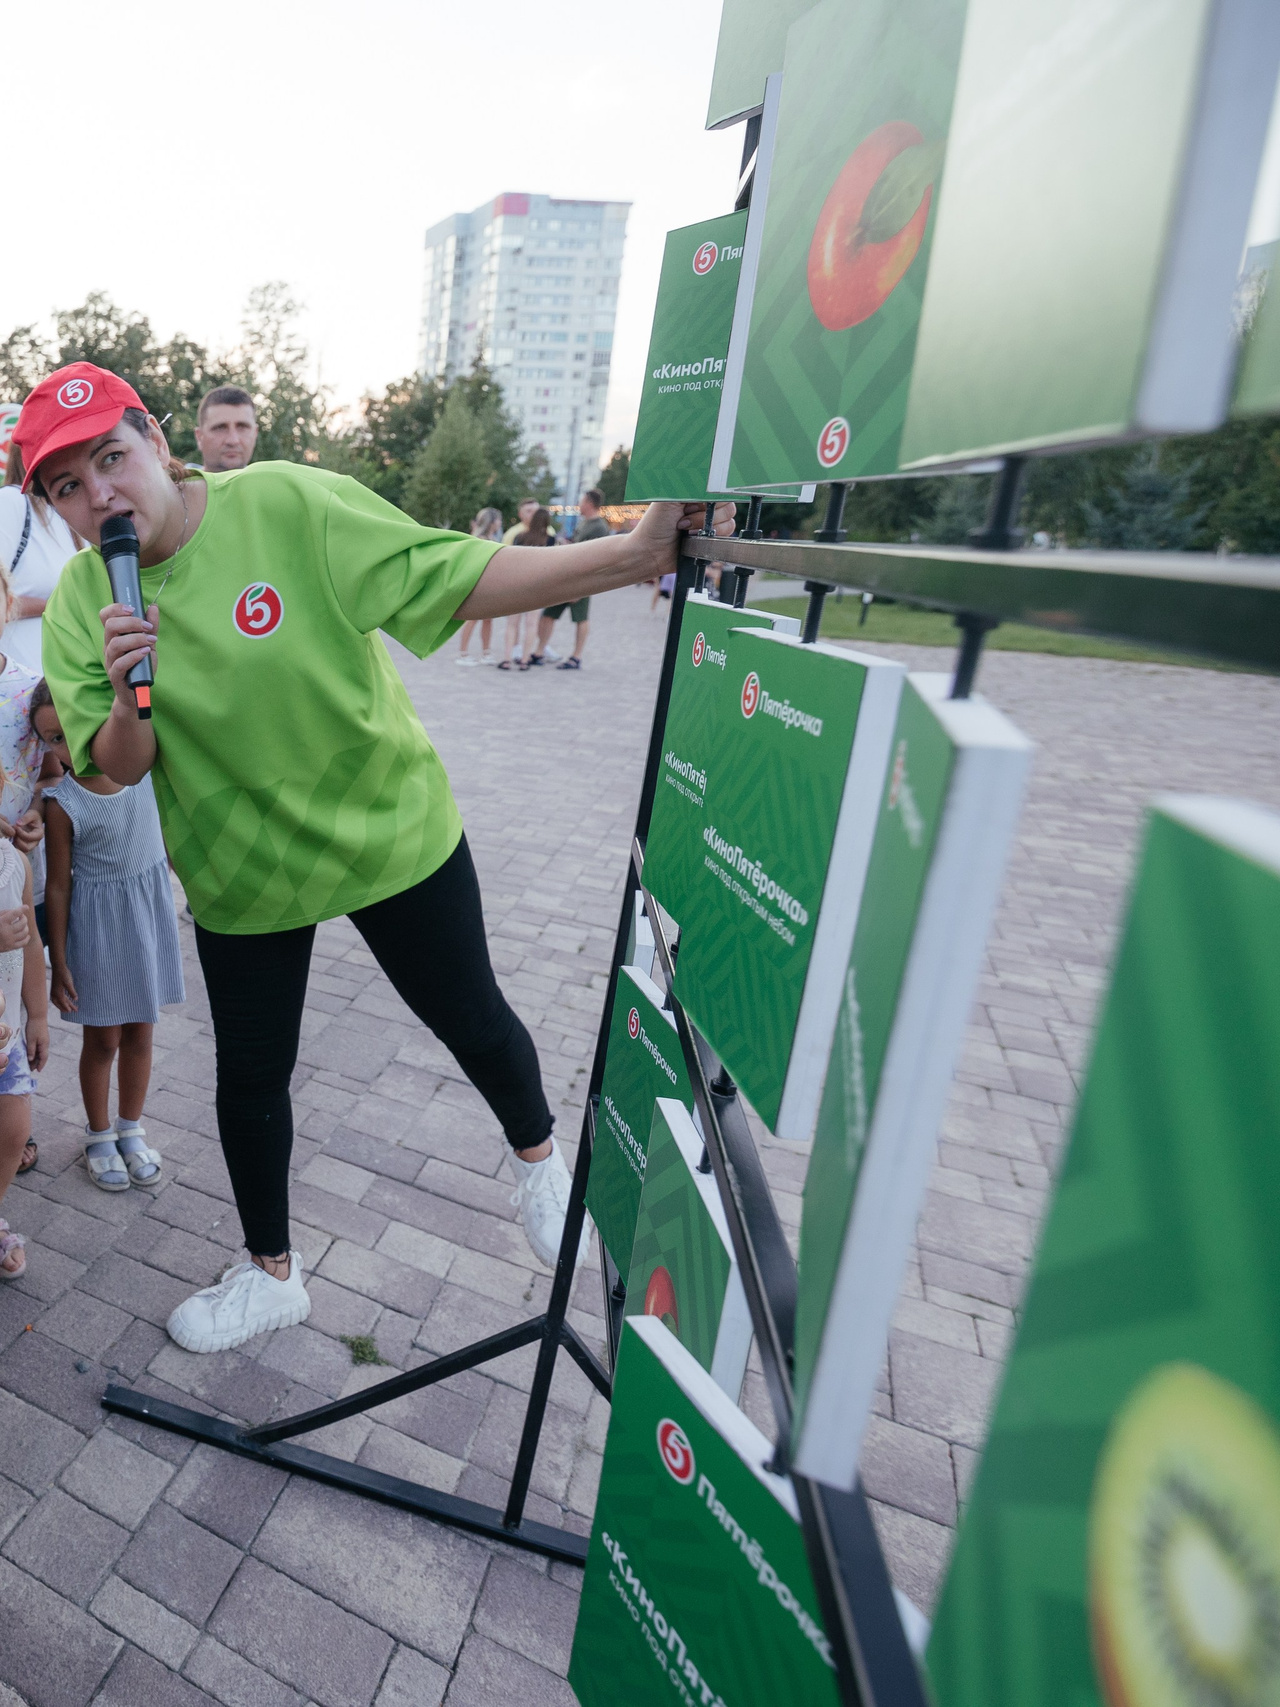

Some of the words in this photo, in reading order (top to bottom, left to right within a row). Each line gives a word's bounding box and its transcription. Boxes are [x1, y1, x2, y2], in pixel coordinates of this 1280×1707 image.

[697, 243, 715, 270] 5
[652, 357, 727, 379] «КиноПя
[658, 384, 682, 394] кино
[683, 381, 701, 392] под
[245, 584, 272, 629] 5
[759, 690, 823, 737] Пятёрочка
[703, 825, 809, 926] «КиноПятёрочка»
[704, 855, 720, 875] кино
[719, 868, 732, 890] под
[732, 880, 768, 921] открытым
[767, 912, 796, 947] небом
[639, 1026, 678, 1086] Пятёрочка
[609, 1569, 641, 1623] кино
[641, 1621, 668, 1672] под
